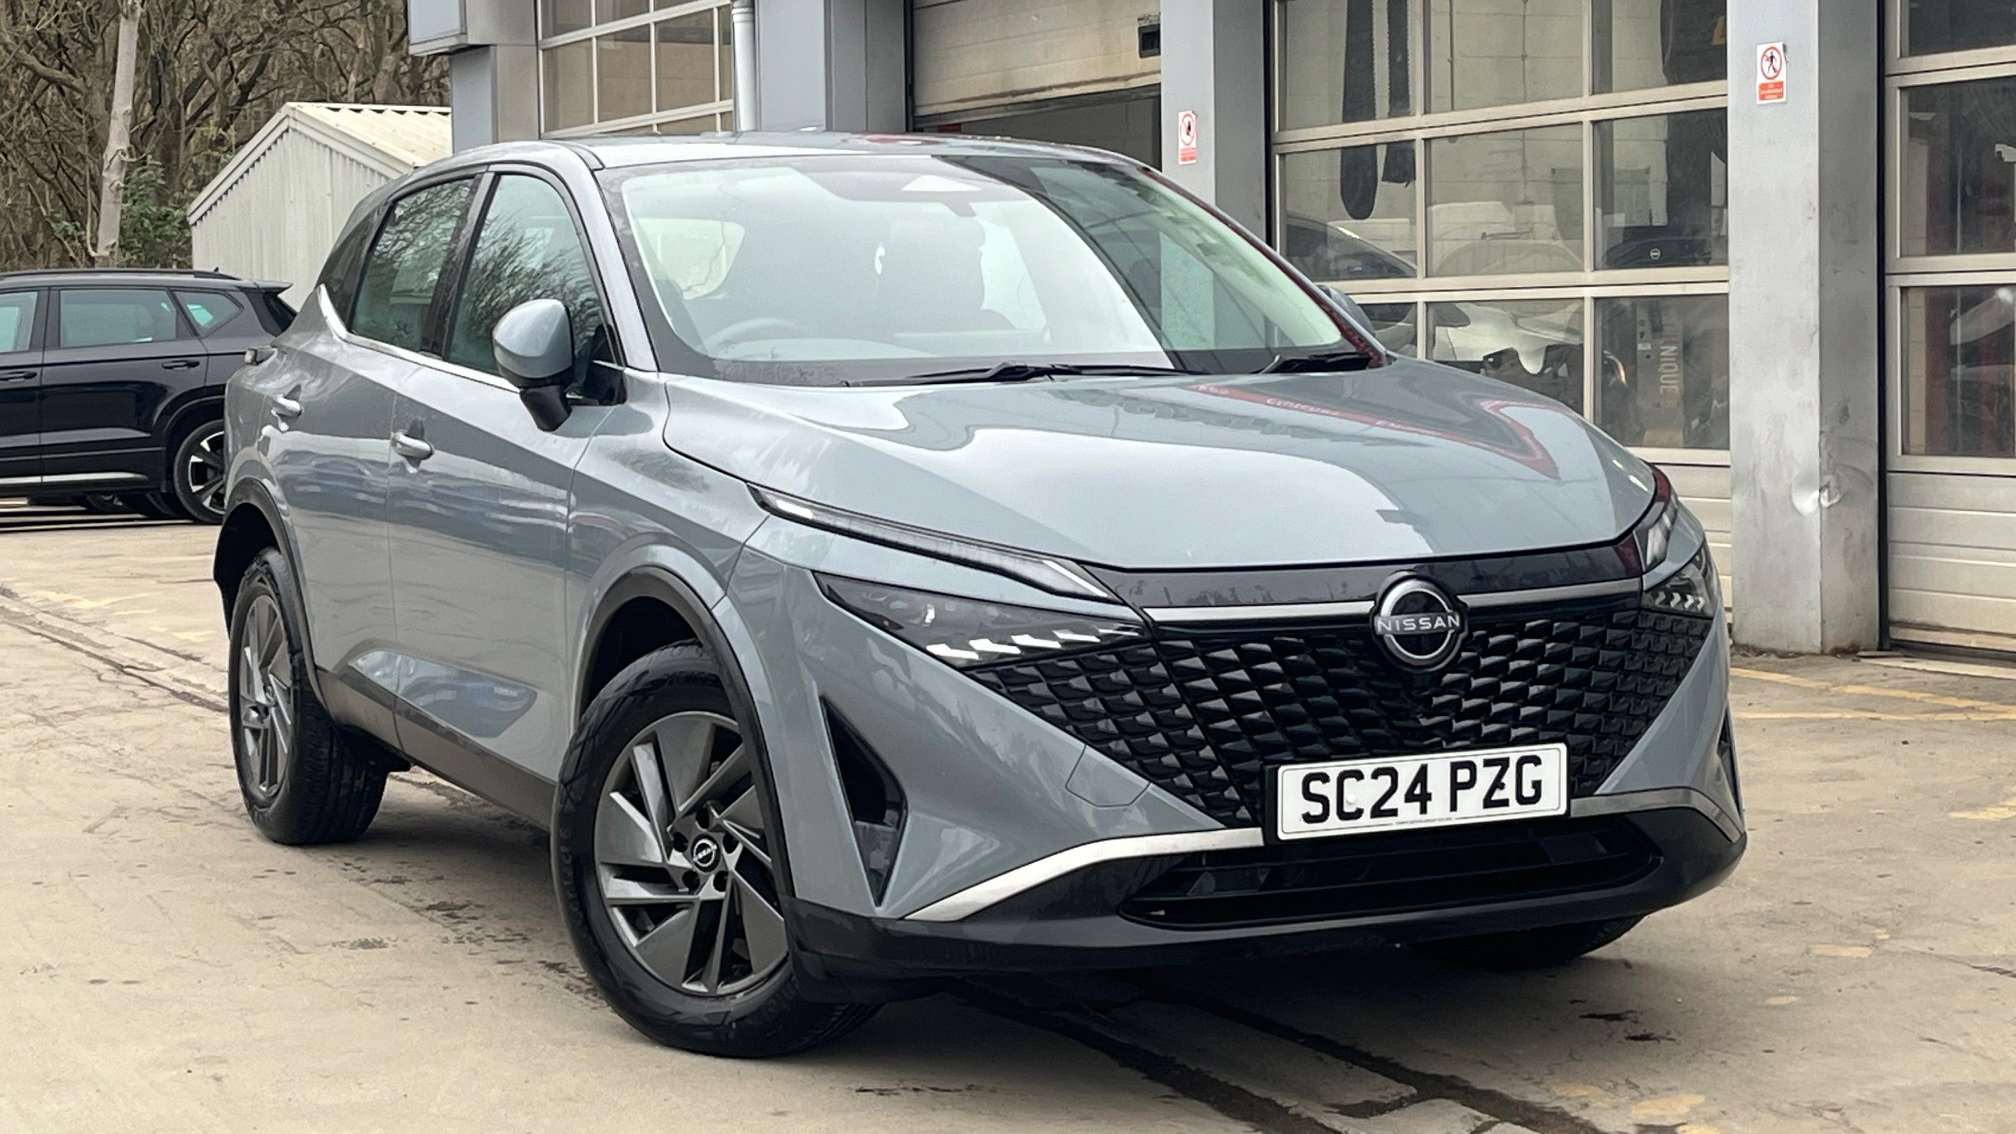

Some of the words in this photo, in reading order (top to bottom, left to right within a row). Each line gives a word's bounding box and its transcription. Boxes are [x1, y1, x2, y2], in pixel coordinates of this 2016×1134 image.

[1376, 614, 1460, 633] NISSAN
[1301, 763, 1432, 825] SC24
[1450, 754, 1543, 812] PZG
